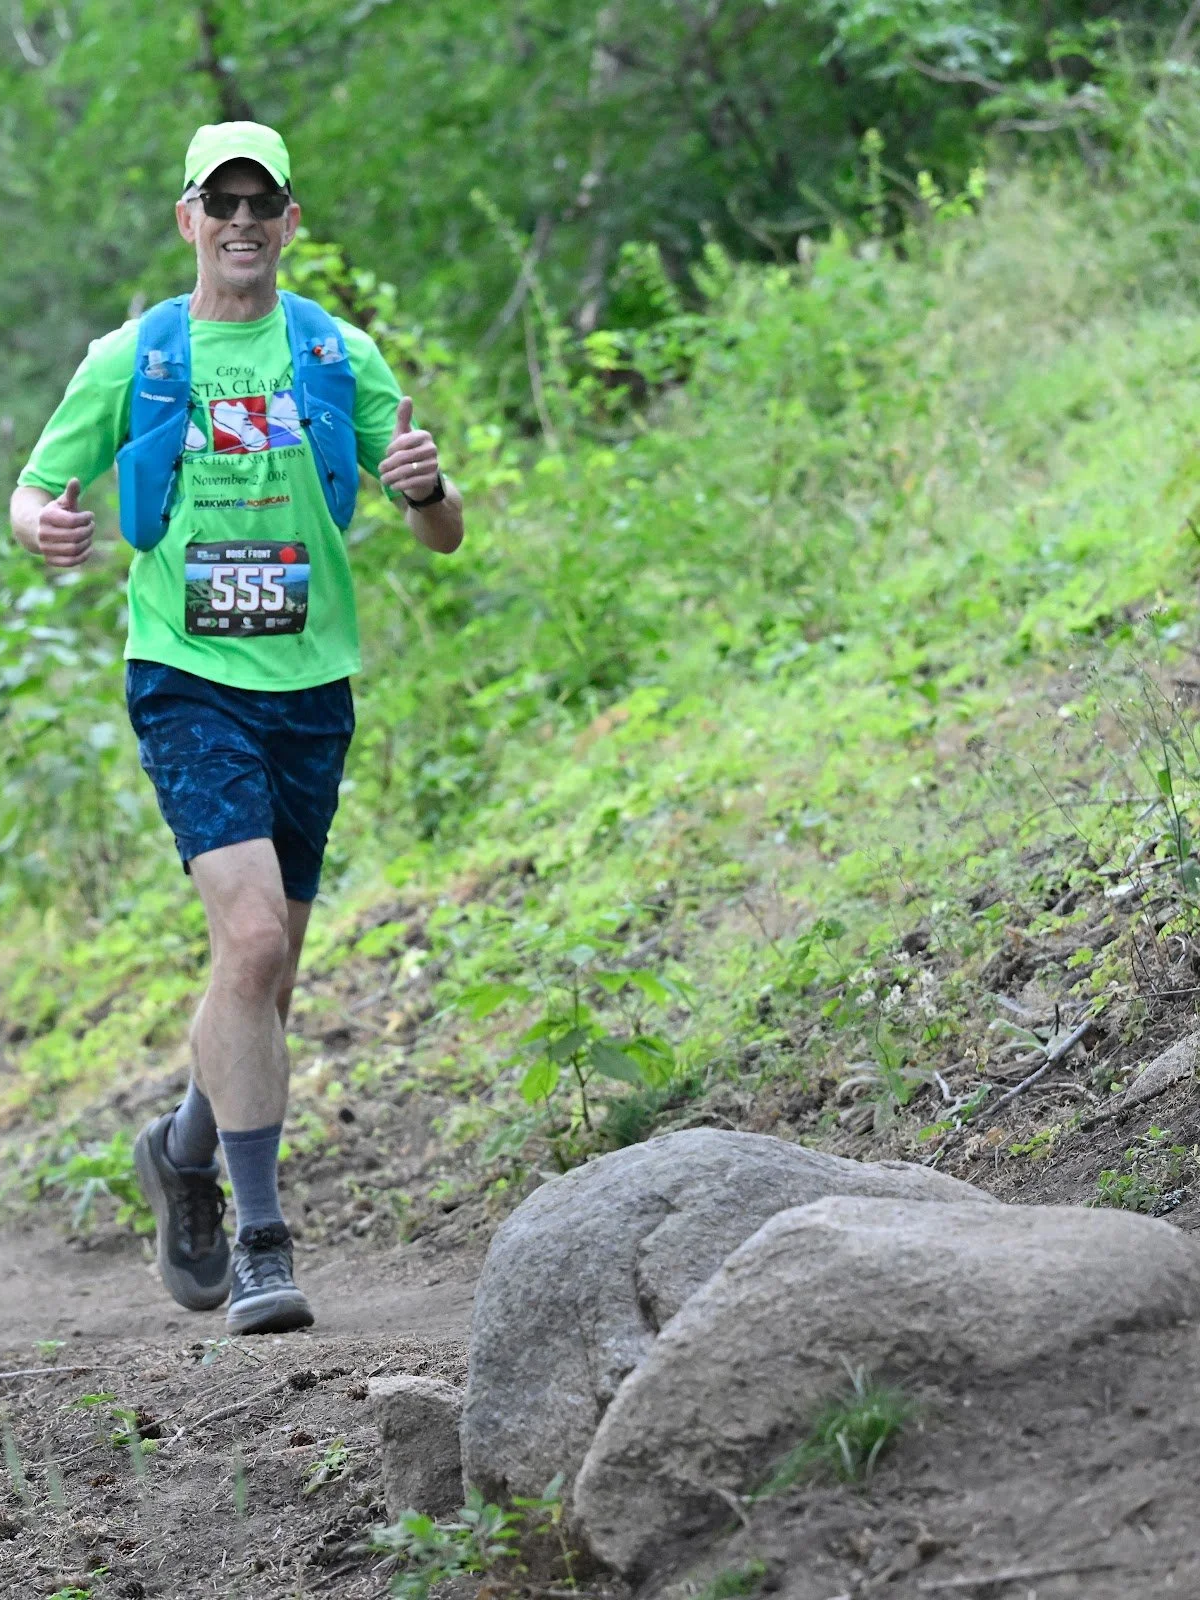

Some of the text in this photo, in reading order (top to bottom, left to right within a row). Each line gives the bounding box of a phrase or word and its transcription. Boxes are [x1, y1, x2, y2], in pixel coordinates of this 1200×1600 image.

[216, 365, 256, 377] City of
[192, 473, 249, 486] November
[265, 470, 288, 484] 008
[193, 499, 237, 508] PARKWAY
[211, 566, 285, 612] 555
